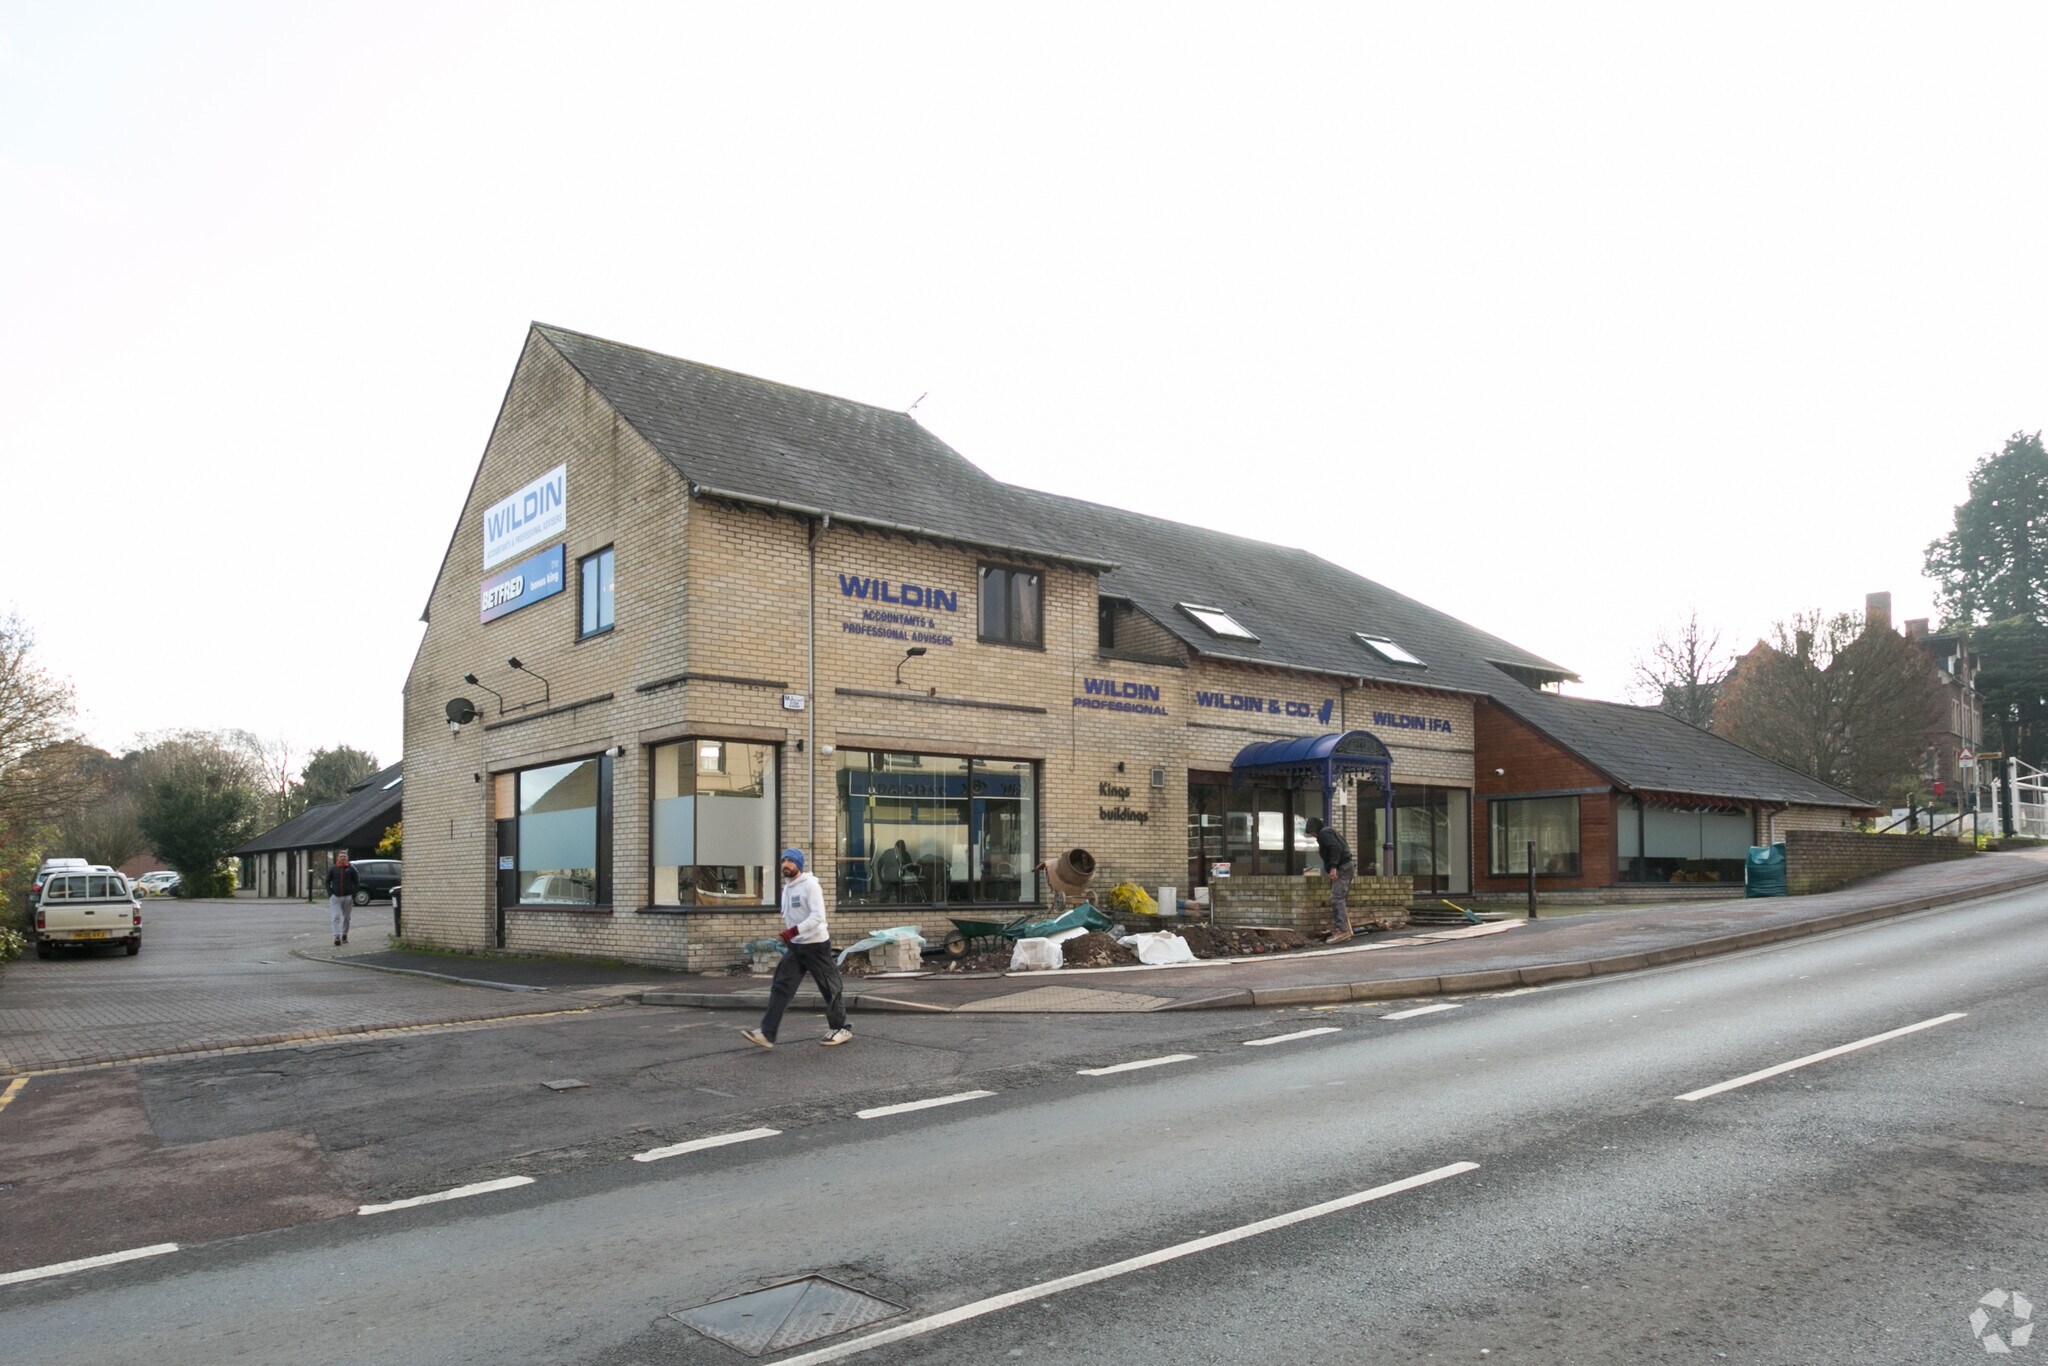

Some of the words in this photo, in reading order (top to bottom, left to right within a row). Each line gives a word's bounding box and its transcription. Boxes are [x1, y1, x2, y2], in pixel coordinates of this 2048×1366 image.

[488, 476, 562, 542] WILDIN
[530, 577, 546, 591] bonus
[547, 572, 559, 583] king
[838, 573, 957, 612] WILDIN
[482, 575, 525, 612] BETFRED
[863, 610, 926, 627] ACCOUNTANTS
[928, 618, 935, 628] &
[842, 622, 909, 641] PROFESSIONAL
[911, 632, 953, 646] ADVISERS
[1084, 678, 1160, 701] WILDIN
[1073, 697, 1169, 716] PROFESSIONAL
[1196, 691, 1263, 712] WILDIN
[1268, 698, 1281, 714] &
[1285, 701, 1315, 717] CO.
[1373, 711, 1425, 730] WILDIN
[1429, 718, 1452, 733] IFA
[1099, 781, 1130, 801] Kings
[1100, 806, 1149, 826] buildings
